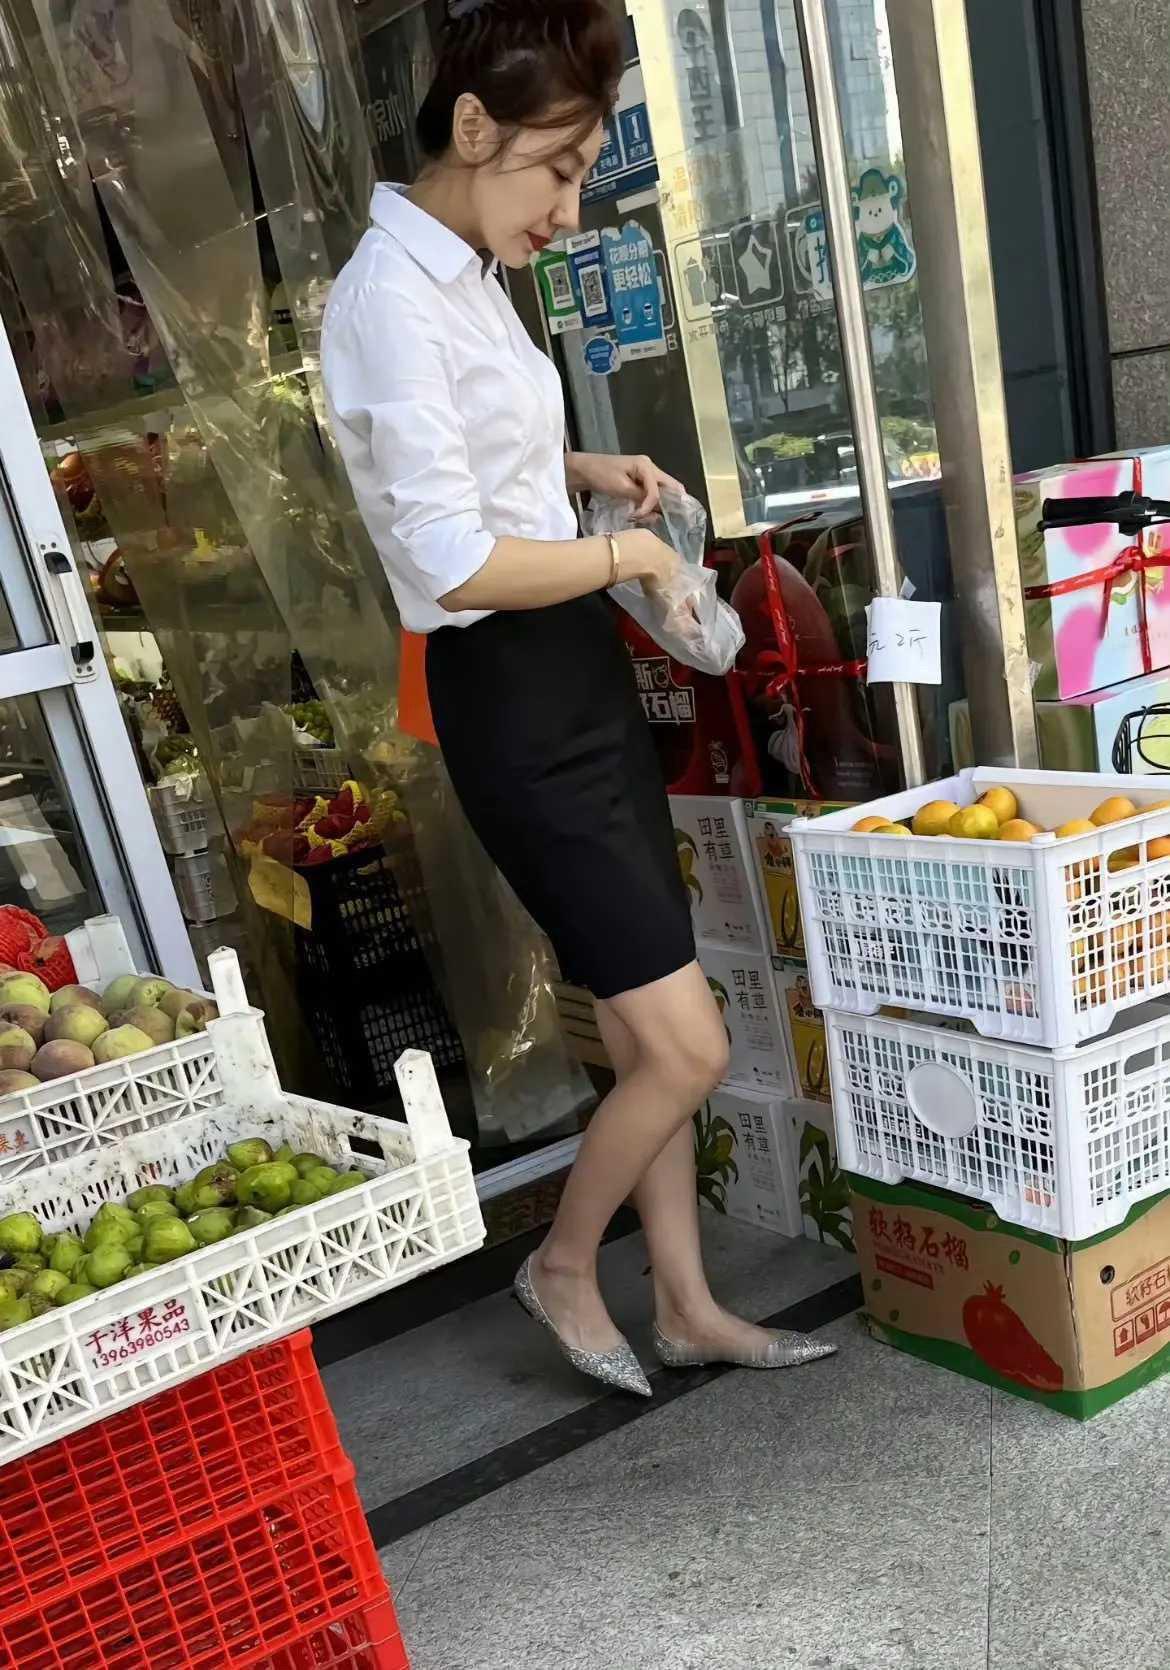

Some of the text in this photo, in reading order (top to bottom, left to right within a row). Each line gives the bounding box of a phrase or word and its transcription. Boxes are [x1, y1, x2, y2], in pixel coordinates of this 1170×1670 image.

[612, 262, 652, 292] 更轻松
[1126, 1265, 1170, 1306] 软籽石
[92, 1318, 190, 1369] 13963980543
